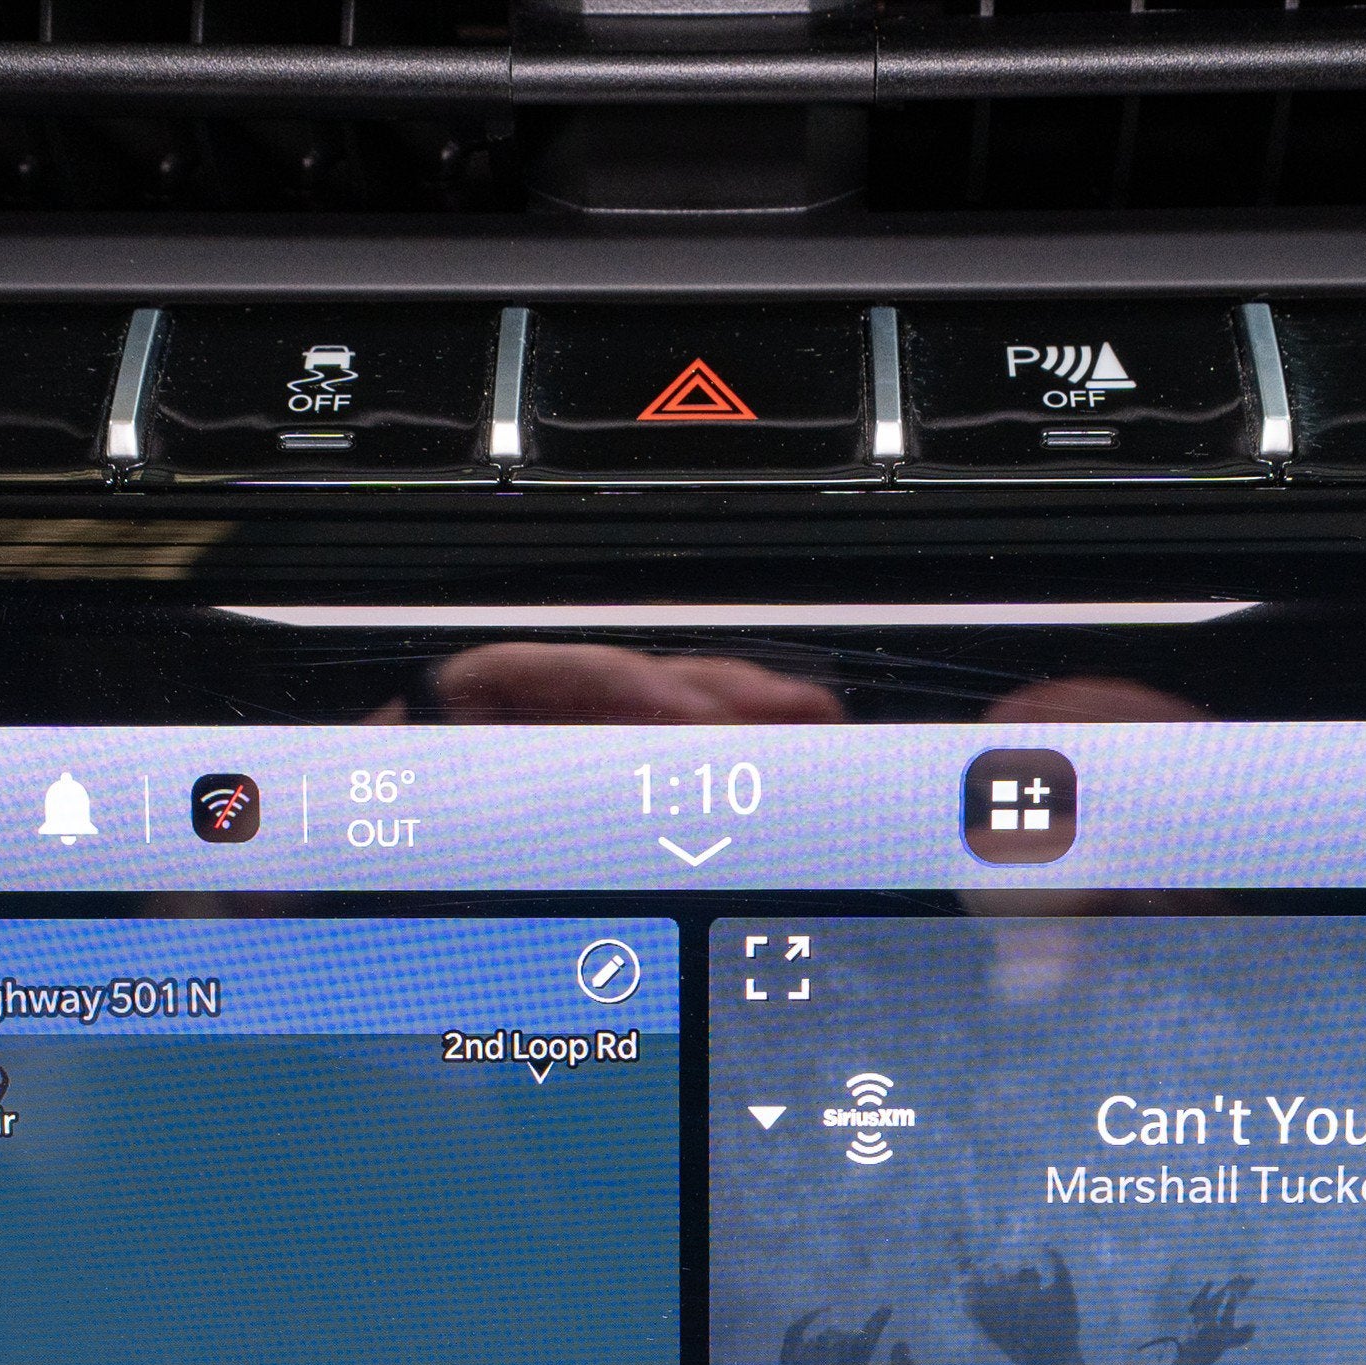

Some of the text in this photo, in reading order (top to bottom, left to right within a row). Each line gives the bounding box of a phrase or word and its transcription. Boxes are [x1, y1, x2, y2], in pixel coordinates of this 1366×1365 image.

[1008, 346, 1041, 377] P
[287, 393, 352, 412] OFF
[1043, 390, 1107, 409] OFF
[350, 769, 417, 804] 86°
[634, 761, 763, 816] 1:10
[347, 818, 421, 849] OUT
[111, 982, 174, 1015] 501
[190, 982, 221, 1014] N
[444, 1032, 638, 1067] 2nd Loop Rd
[1096, 1095, 1251, 1146] Can't
[1046, 1165, 1237, 1205] Marshall
